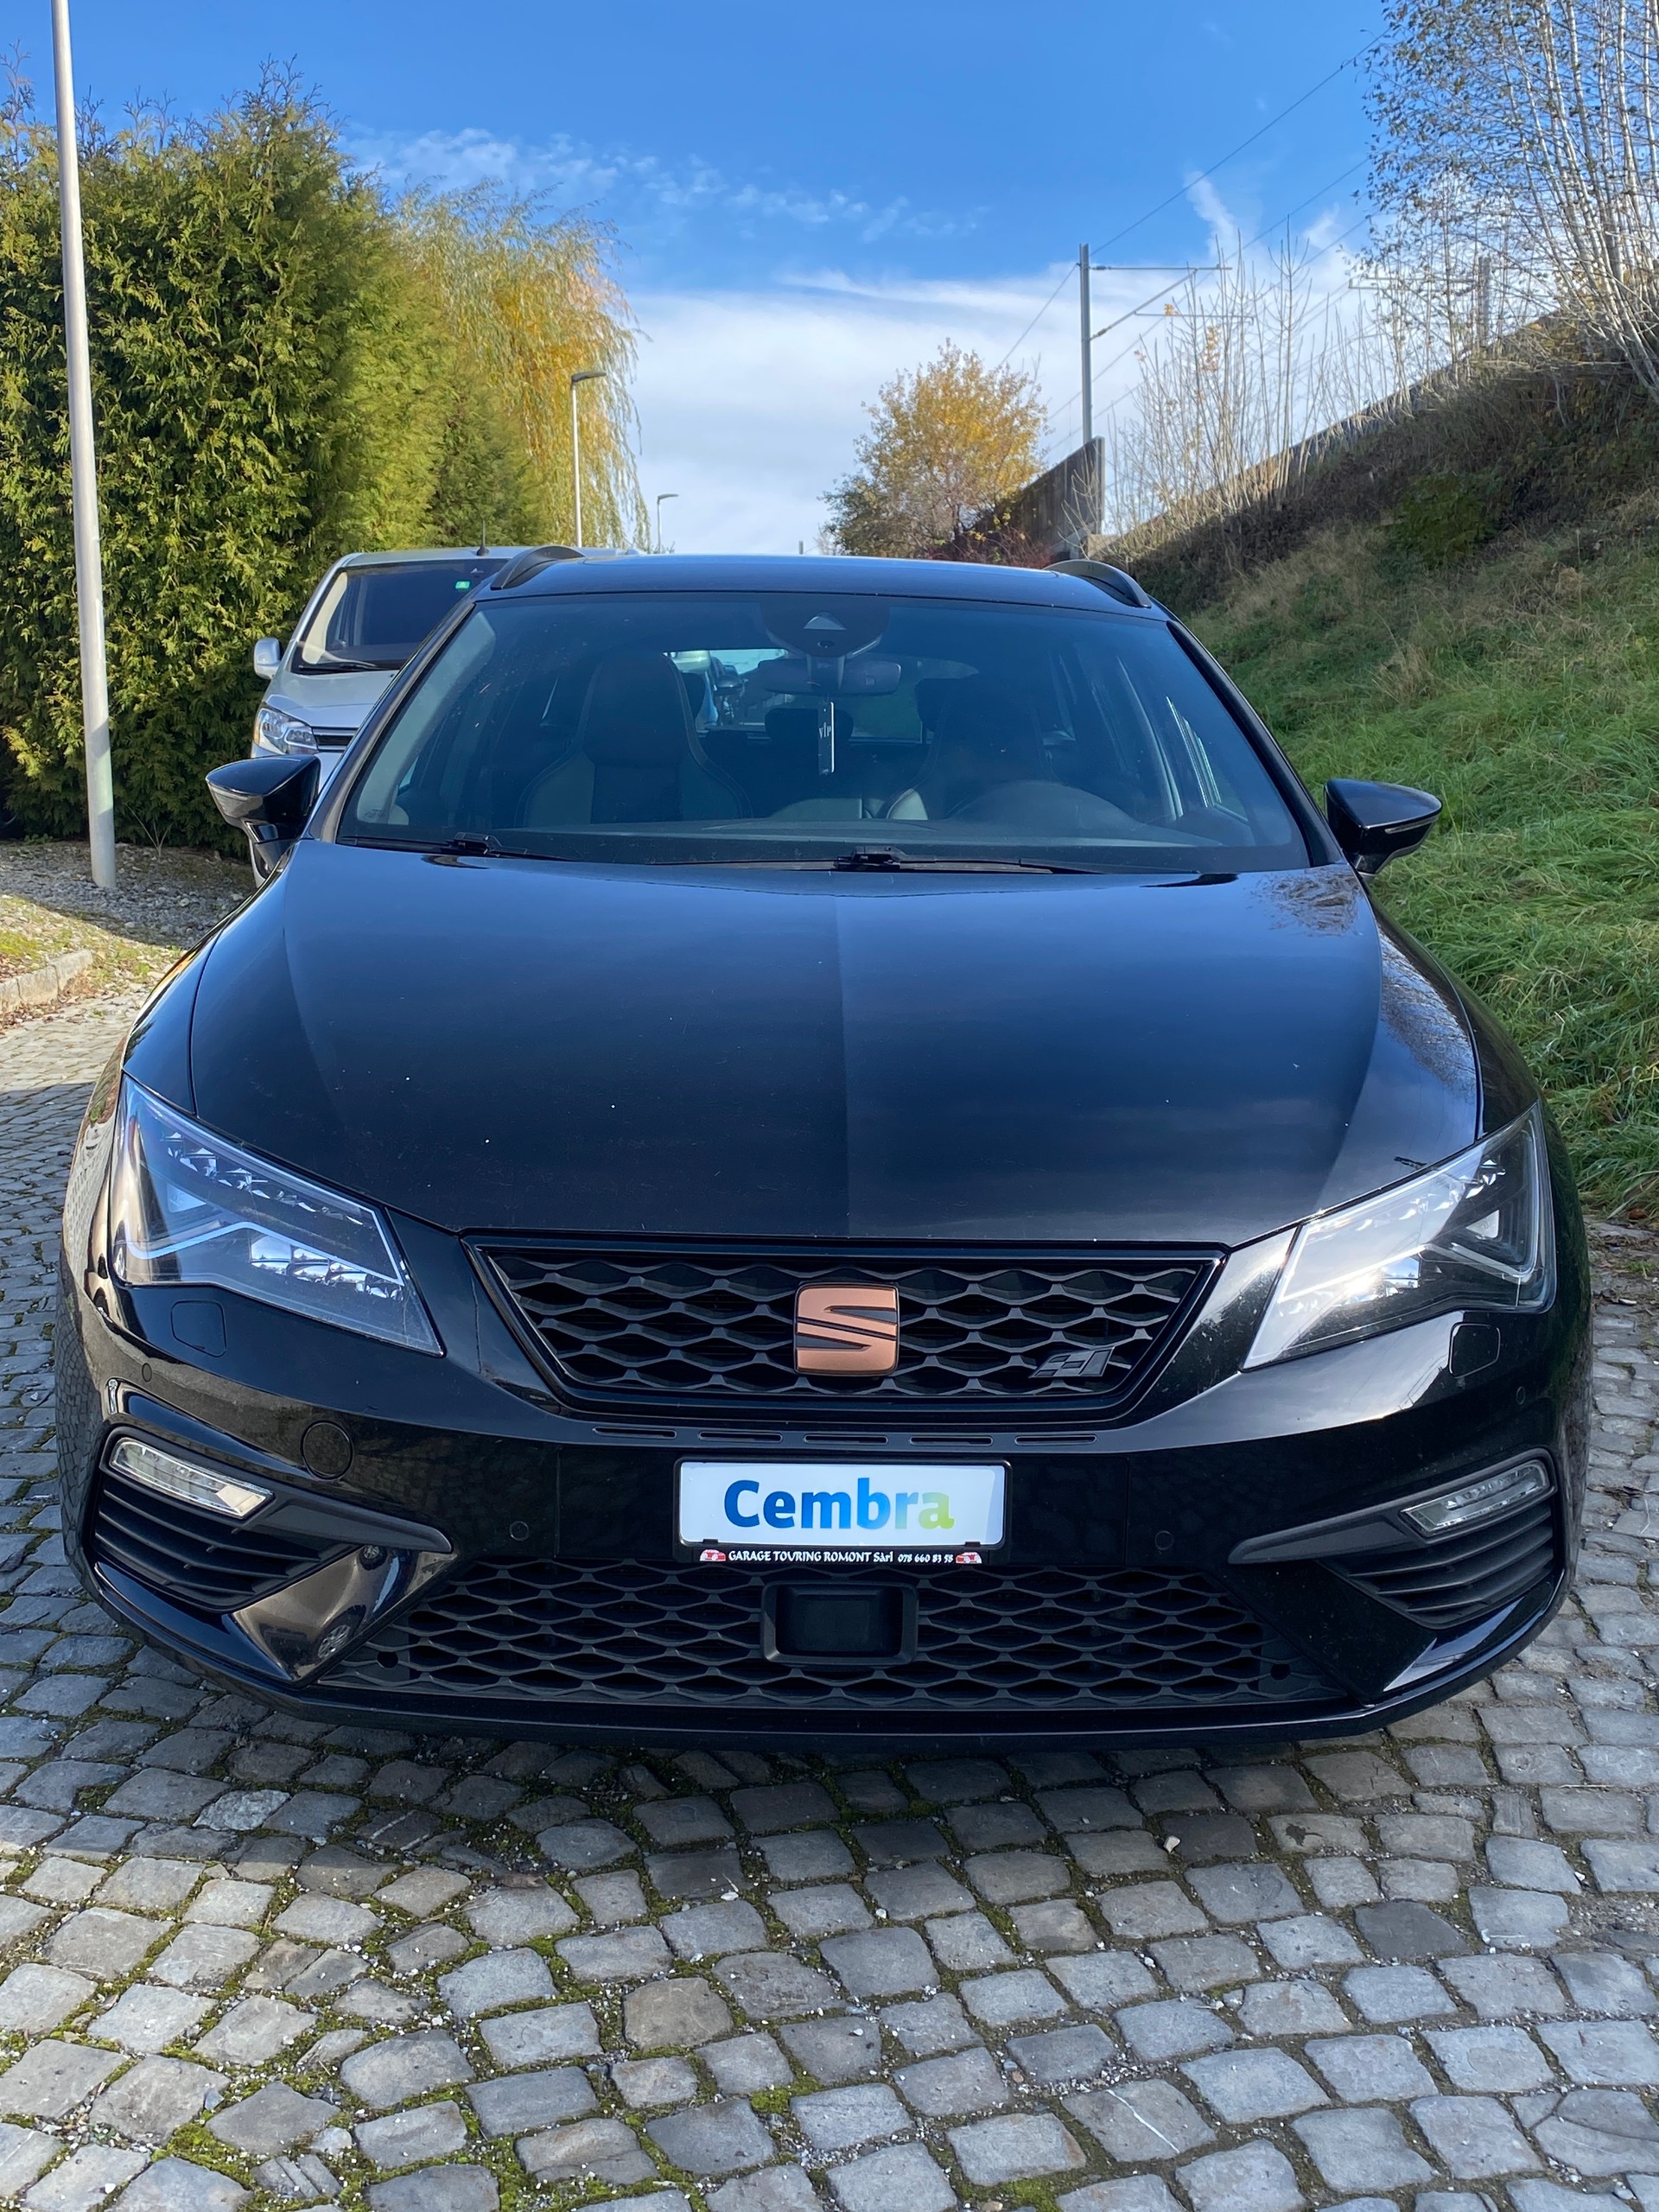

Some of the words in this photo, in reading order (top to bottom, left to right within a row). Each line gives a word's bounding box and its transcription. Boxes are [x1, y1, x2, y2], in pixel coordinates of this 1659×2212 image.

[723, 1478, 955, 1530] Cembra
[728, 1550, 772, 1561] GARAGE
[773, 1551, 822, 1562] TOURING
[823, 1551, 872, 1563] ROMONT
[897, 1554, 912, 1563] 078
[914, 1554, 931, 1563] 660
